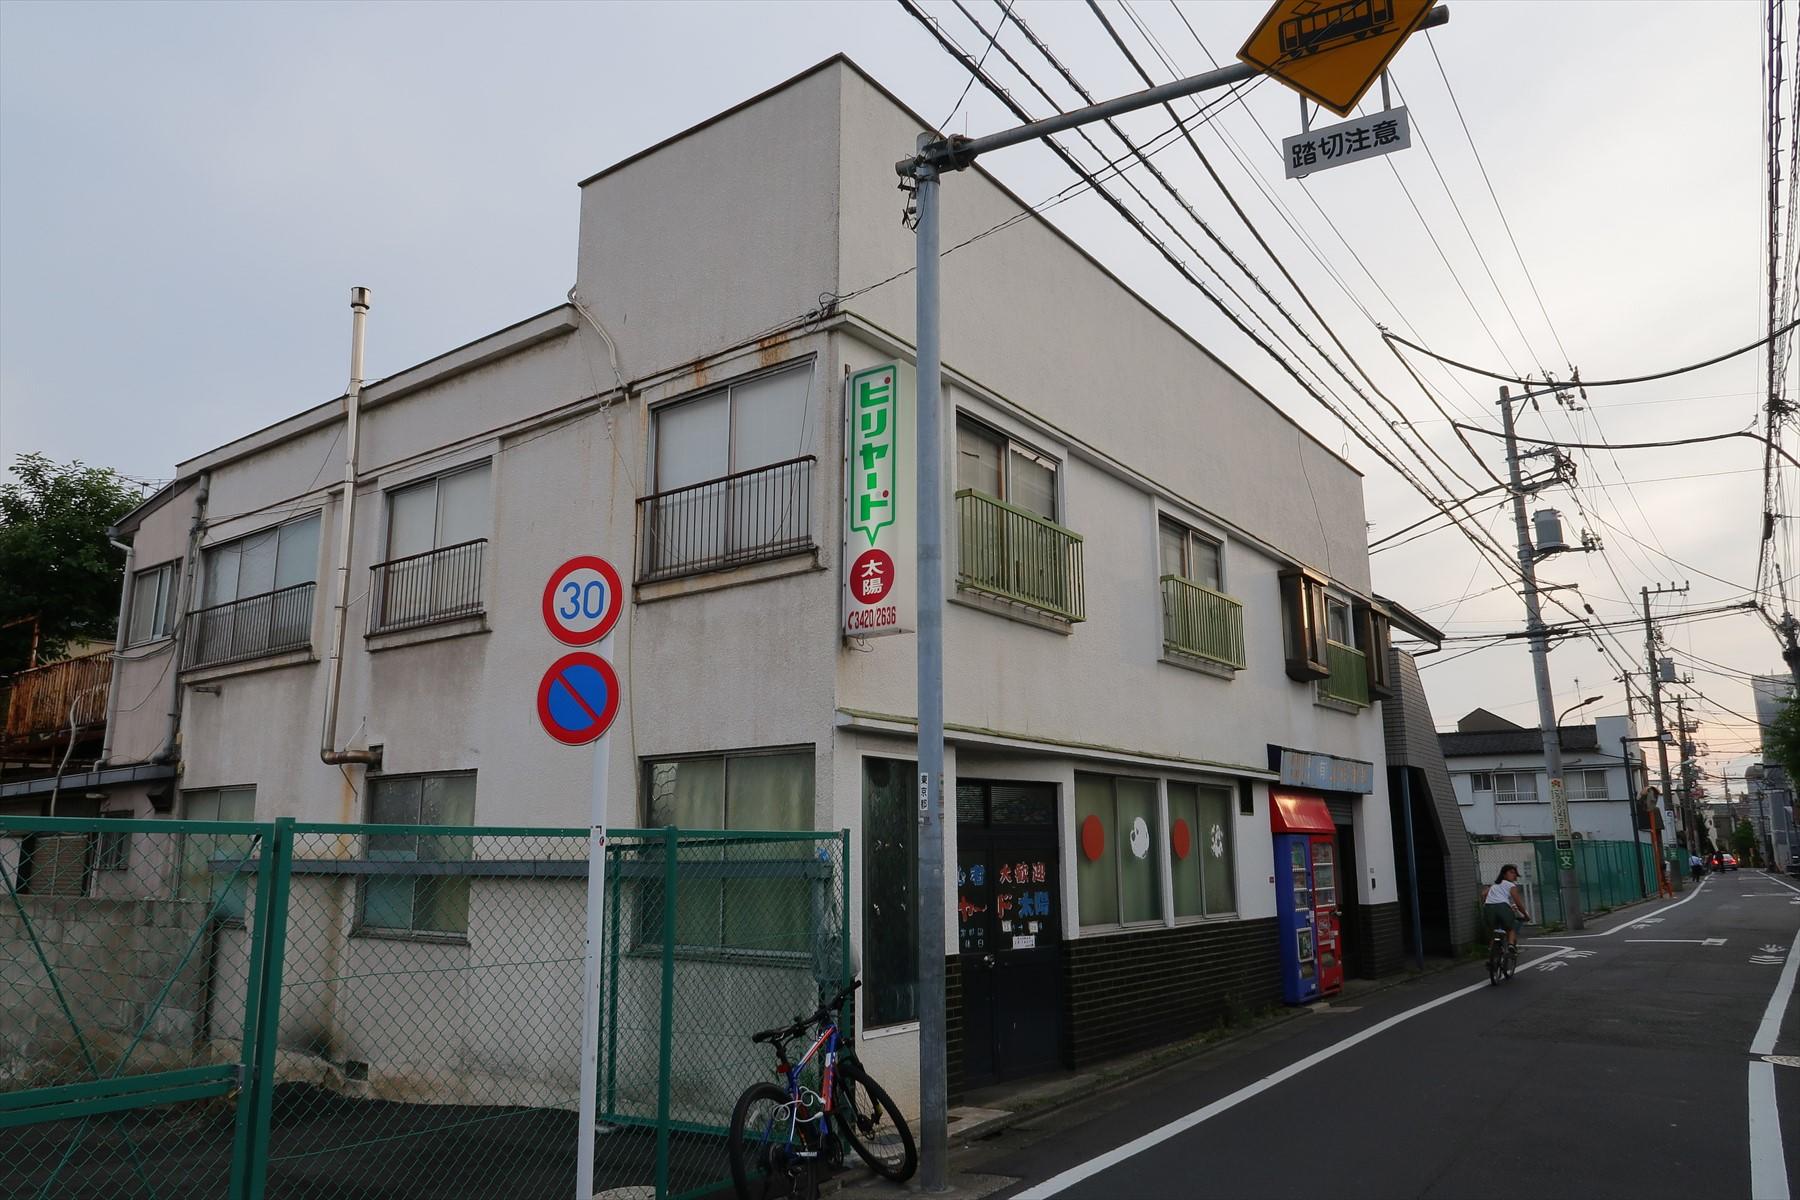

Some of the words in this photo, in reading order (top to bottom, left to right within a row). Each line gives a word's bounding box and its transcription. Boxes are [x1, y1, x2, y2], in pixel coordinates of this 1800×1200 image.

[1291, 119, 1400, 169] 踏切注意
[859, 376, 891, 522] ビリヤード
[861, 559, 883, 596] 太陽
[560, 580, 605, 620] 30
[854, 608, 874, 629] 3420
[876, 606, 896, 627] 2636
